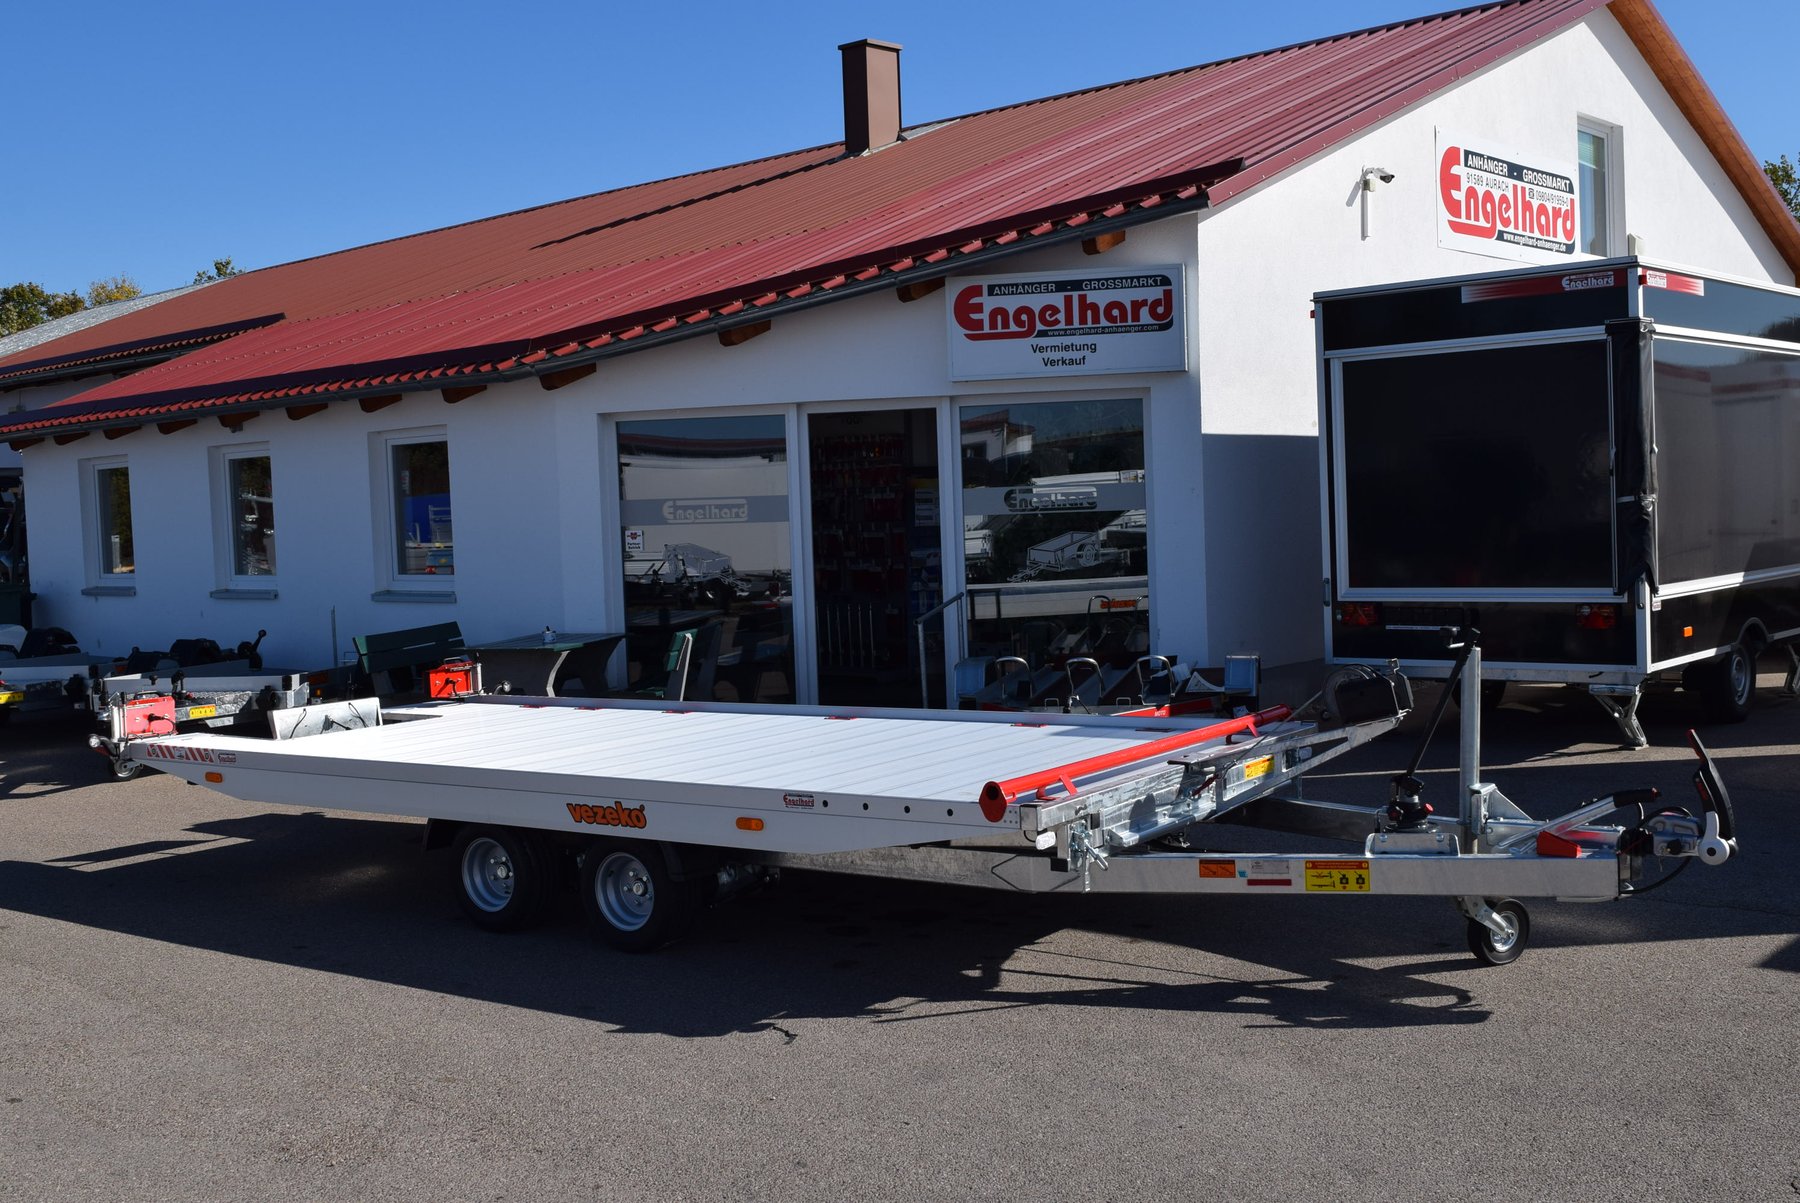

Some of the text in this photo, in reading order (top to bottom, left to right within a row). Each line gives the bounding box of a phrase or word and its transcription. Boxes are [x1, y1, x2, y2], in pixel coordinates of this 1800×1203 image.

[1466, 172, 1509, 193] 91589 AURACH
[1467, 153, 1508, 177] ANHÄNGER
[1522, 169, 1570, 192] GROSSMARKT
[1440, 146, 1575, 242] Engelhard
[1503, 232, 1566, 253] www.engelhard-anhaenger.de
[993, 281, 1056, 295] ANHÄNGER
[1082, 277, 1162, 290] GROSSMARKT
[1562, 274, 1614, 291] Engelhard
[953, 284, 1174, 341] Engelhard
[1047, 324, 1159, 336] www.engelhard-anhaenger.com
[1031, 342, 1097, 354] Vermietung
[1042, 355, 1086, 367] Verkauf
[1004, 487, 1097, 512] Engelhard
[662, 499, 749, 524] Engelhard
[566, 801, 647, 829] vezeko
